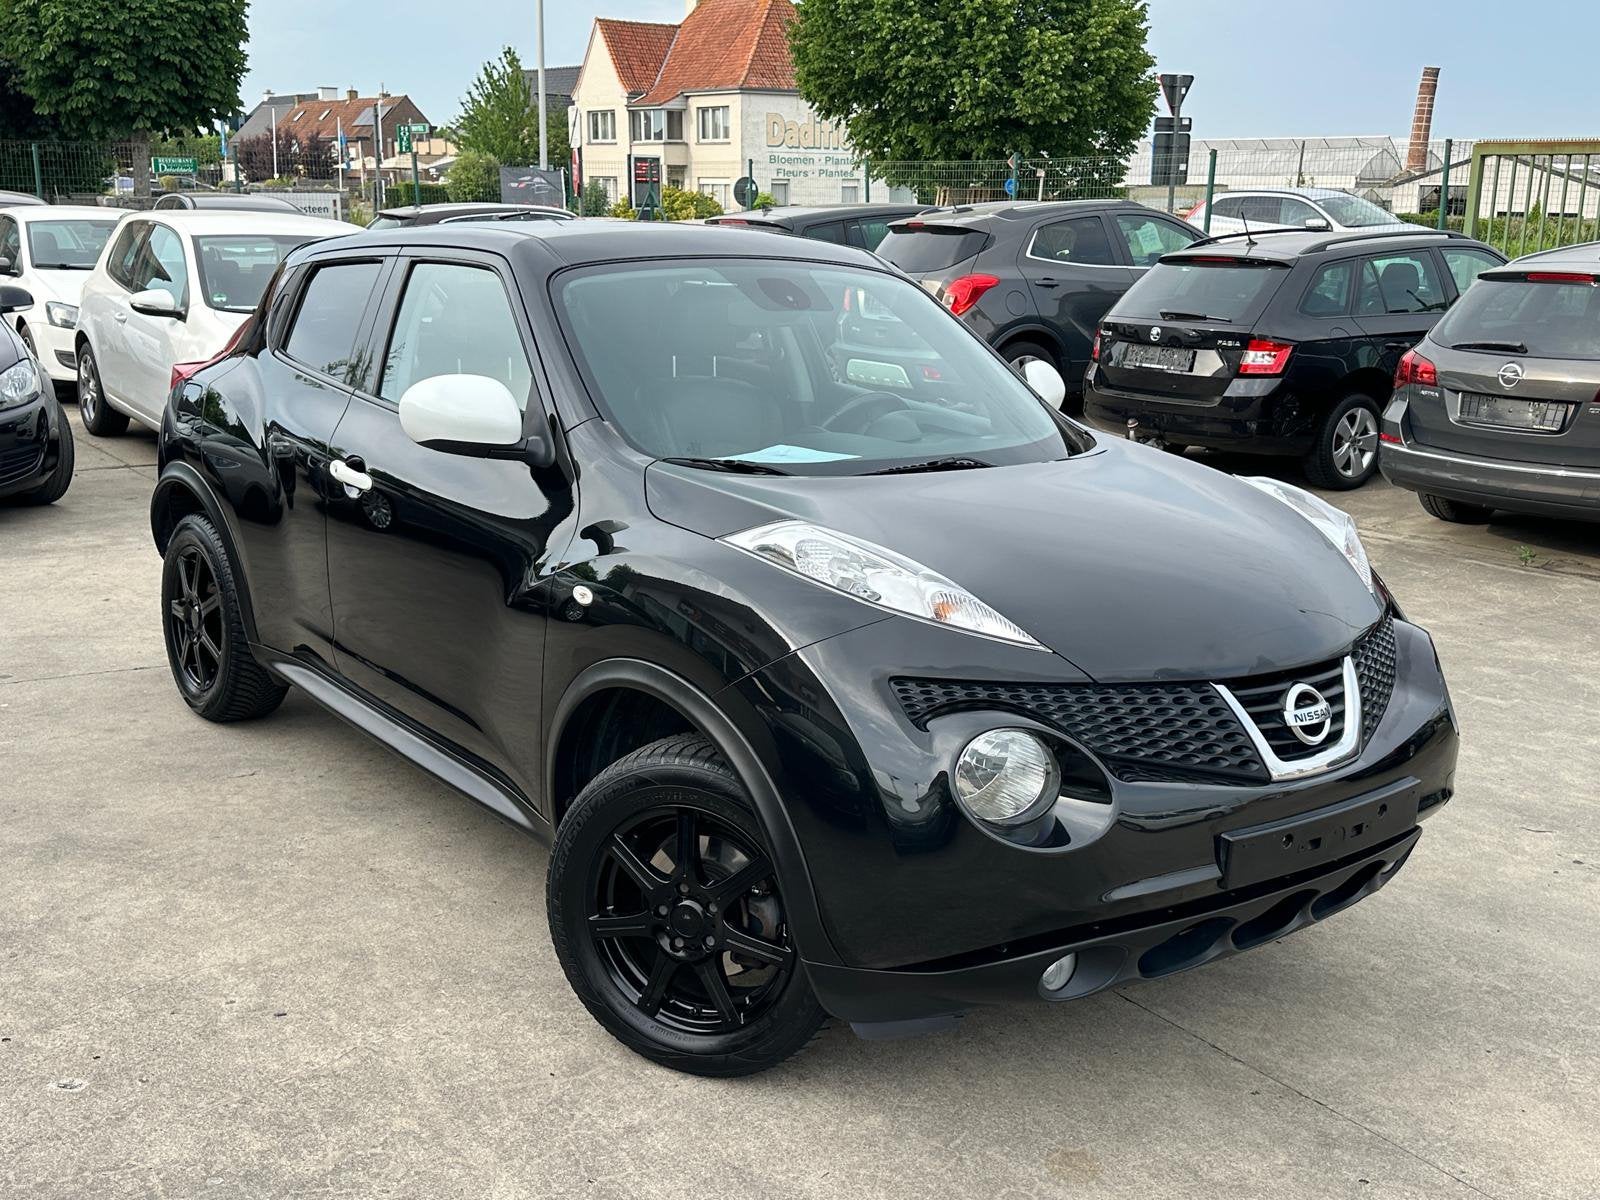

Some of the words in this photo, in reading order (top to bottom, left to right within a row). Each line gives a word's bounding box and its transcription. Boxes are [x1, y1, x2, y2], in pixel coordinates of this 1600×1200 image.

[400, 126, 410, 152] HOTEL
[769, 155, 814, 165] Bloemen
[825, 156, 856, 166] Plante
[776, 168, 809, 178] Fleurs
[818, 169, 854, 178] Plantes
[1294, 707, 1330, 723] NISSAN
